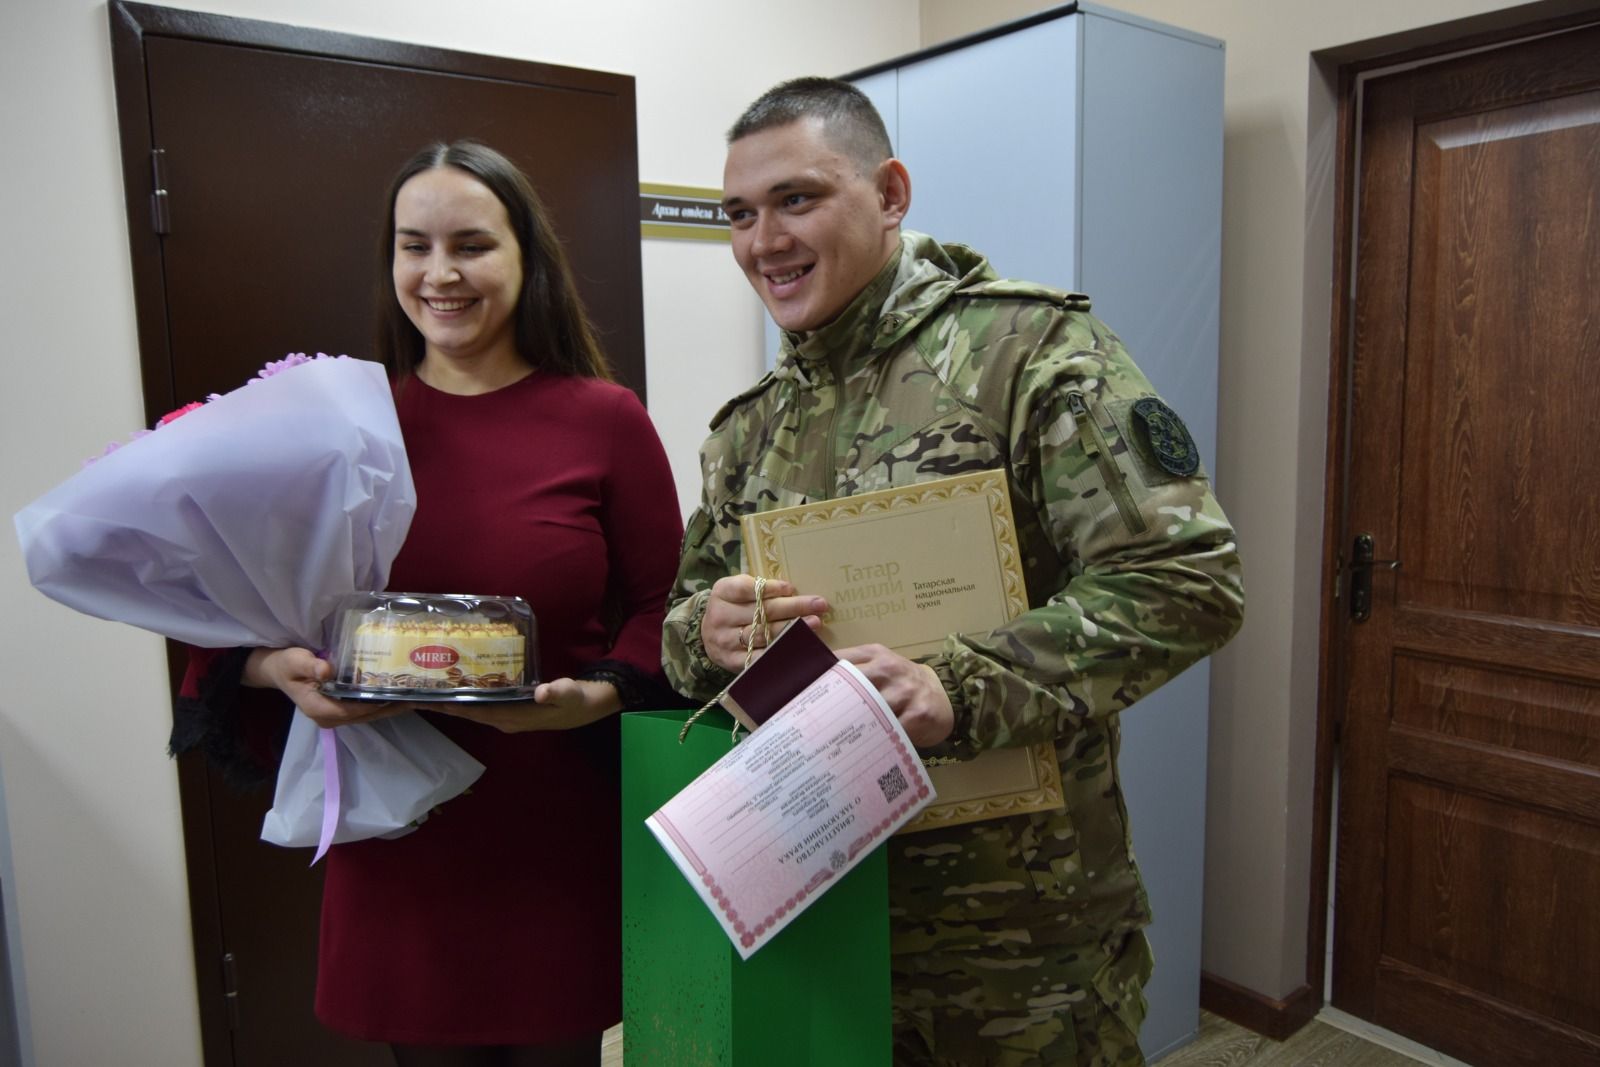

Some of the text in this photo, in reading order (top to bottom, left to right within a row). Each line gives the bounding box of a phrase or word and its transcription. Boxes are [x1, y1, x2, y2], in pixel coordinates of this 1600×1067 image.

[839, 561, 900, 583] Татар
[835, 580, 904, 604] милли
[913, 577, 956, 591] Татарская
[915, 584, 976, 601] национальная
[916, 599, 941, 609] кухня
[414, 651, 454, 663] MIREL
[803, 802, 854, 845] ЗАКЛЮЧЕНИИ
[796, 814, 855, 864] СВИДЕТЕЛЬСТВО
[778, 842, 804, 864] БРАКА
